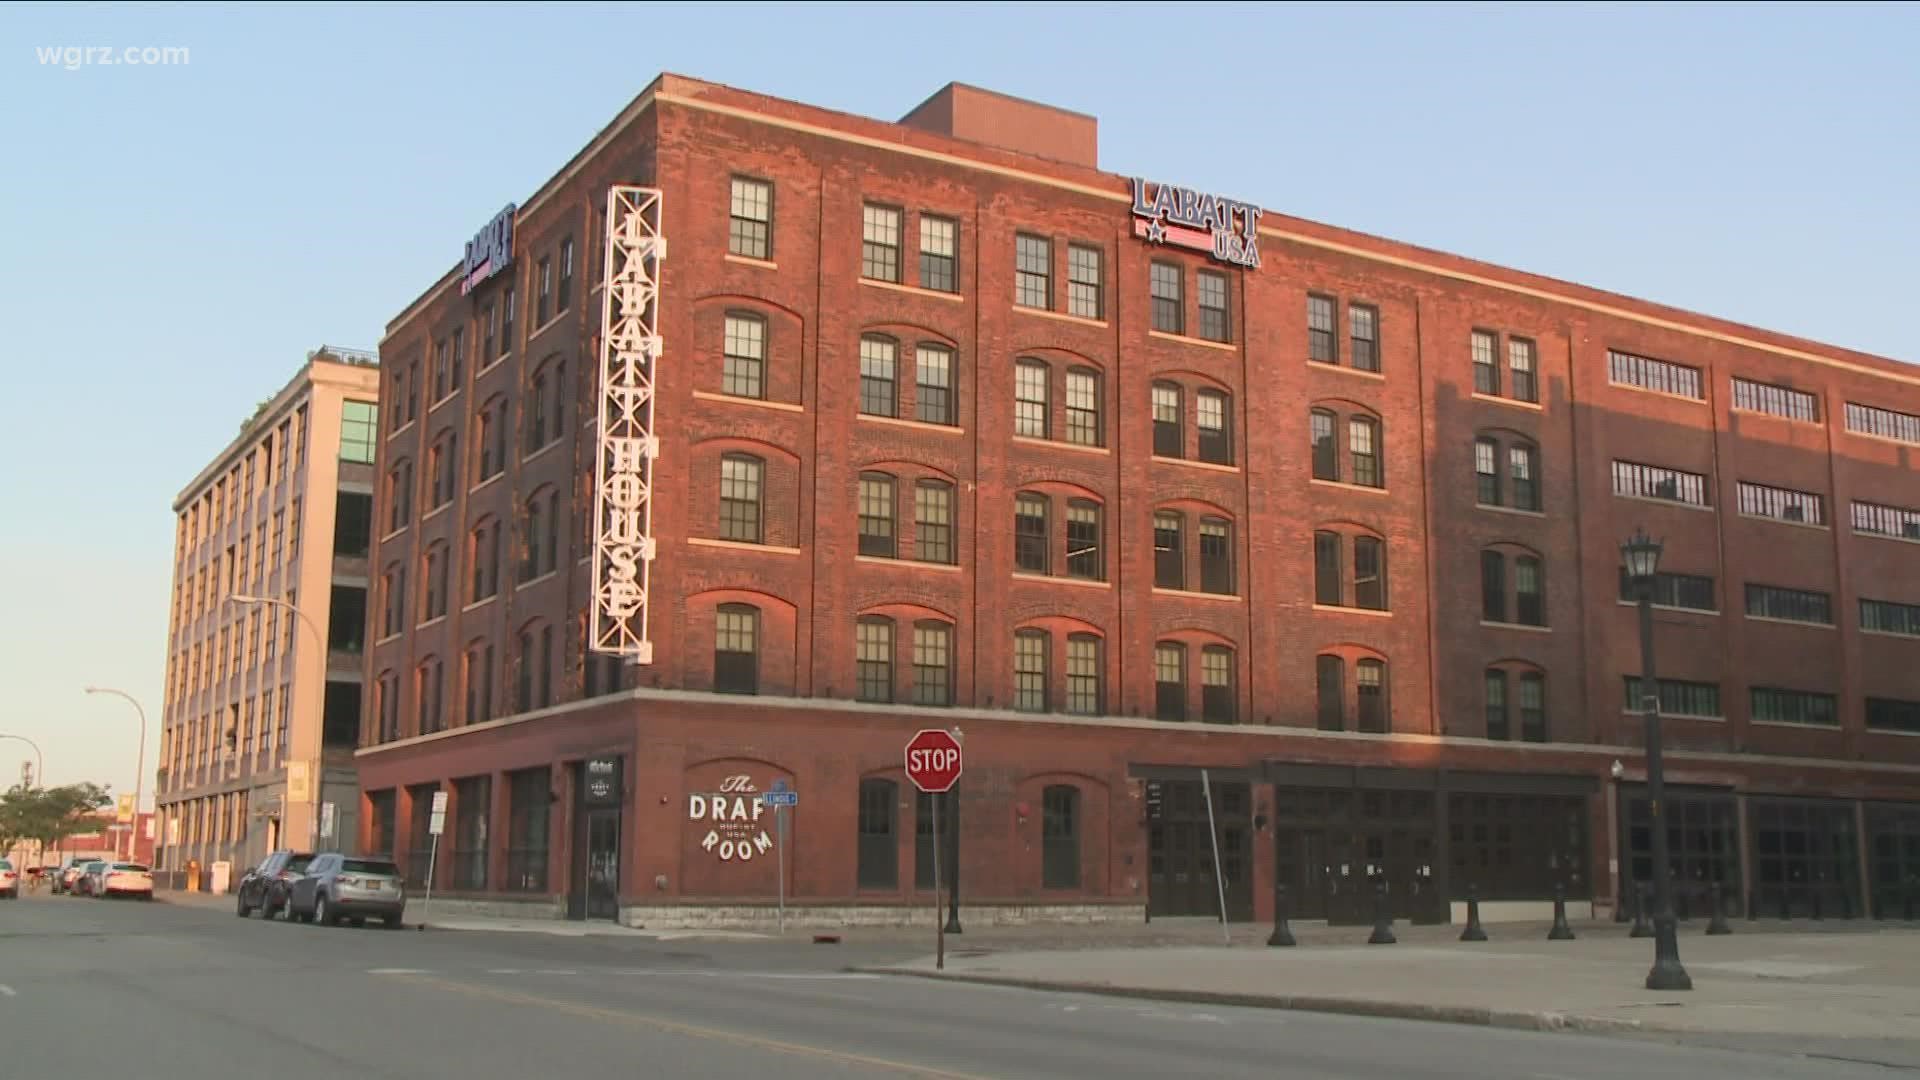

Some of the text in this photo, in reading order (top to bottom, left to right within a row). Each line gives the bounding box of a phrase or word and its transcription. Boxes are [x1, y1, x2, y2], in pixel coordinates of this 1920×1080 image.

[1131, 177, 1262, 237] LABATT
[1211, 229, 1262, 269] USA
[608, 212, 647, 618] LABATT HOUSE
[910, 748, 958, 773] STOP
[719, 775, 758, 793] The
[689, 795, 778, 821] DRAF
[701, 830, 773, 861] ROOM
